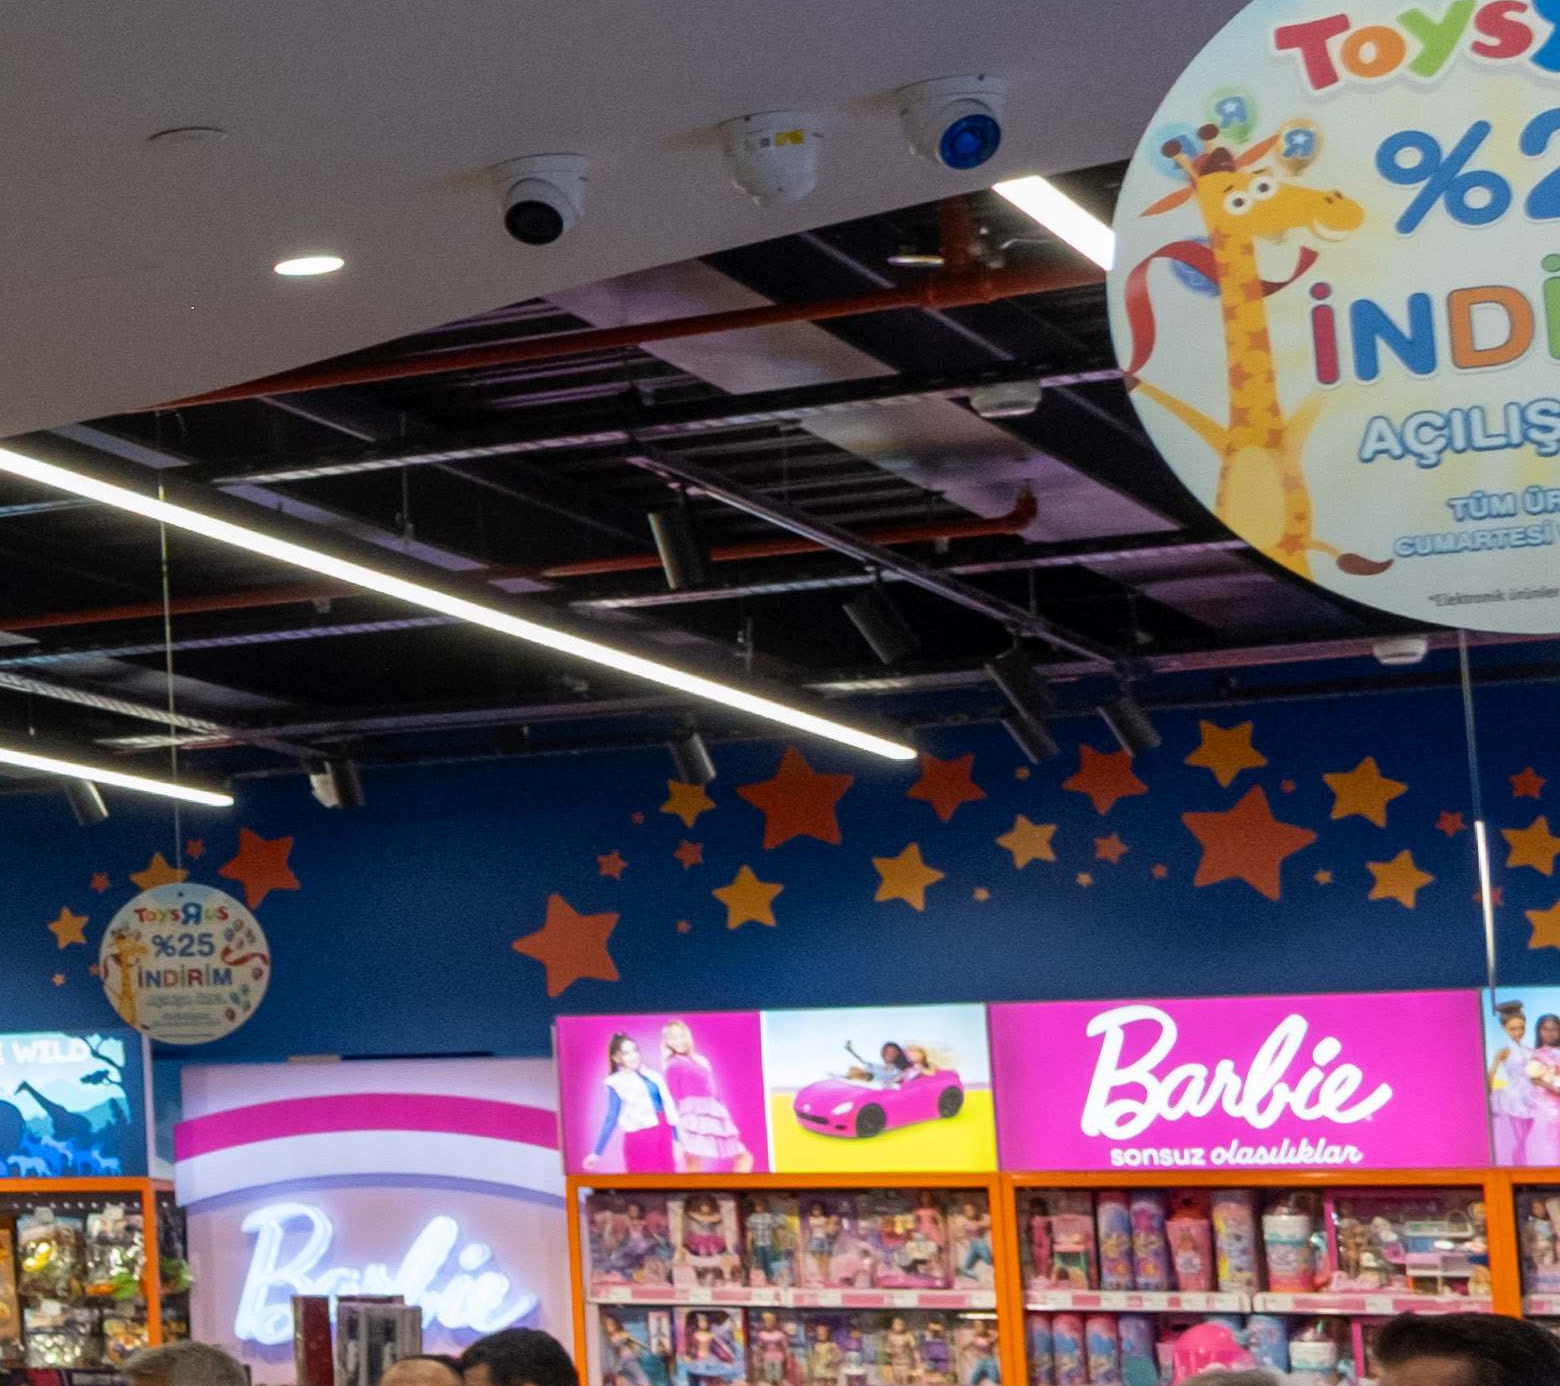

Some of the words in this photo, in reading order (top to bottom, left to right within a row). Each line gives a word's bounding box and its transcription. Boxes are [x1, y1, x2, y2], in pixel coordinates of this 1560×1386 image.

[1359, 398, 1560, 468] AÇILIŞ
[1447, 490, 1517, 522] TÜM
[1394, 520, 1554, 558] CUMARTESİ
[151, 933, 215, 957] %25
[137, 964, 233, 988] İNDİRİM
[12, 1038, 91, 1064] WILD
[1081, 1005, 1393, 1140] Barbie
[1110, 1147, 1206, 1166] sonsuz
[1210, 1137, 1363, 1166] olasılıklar
[234, 1201, 537, 1345] Barbie
